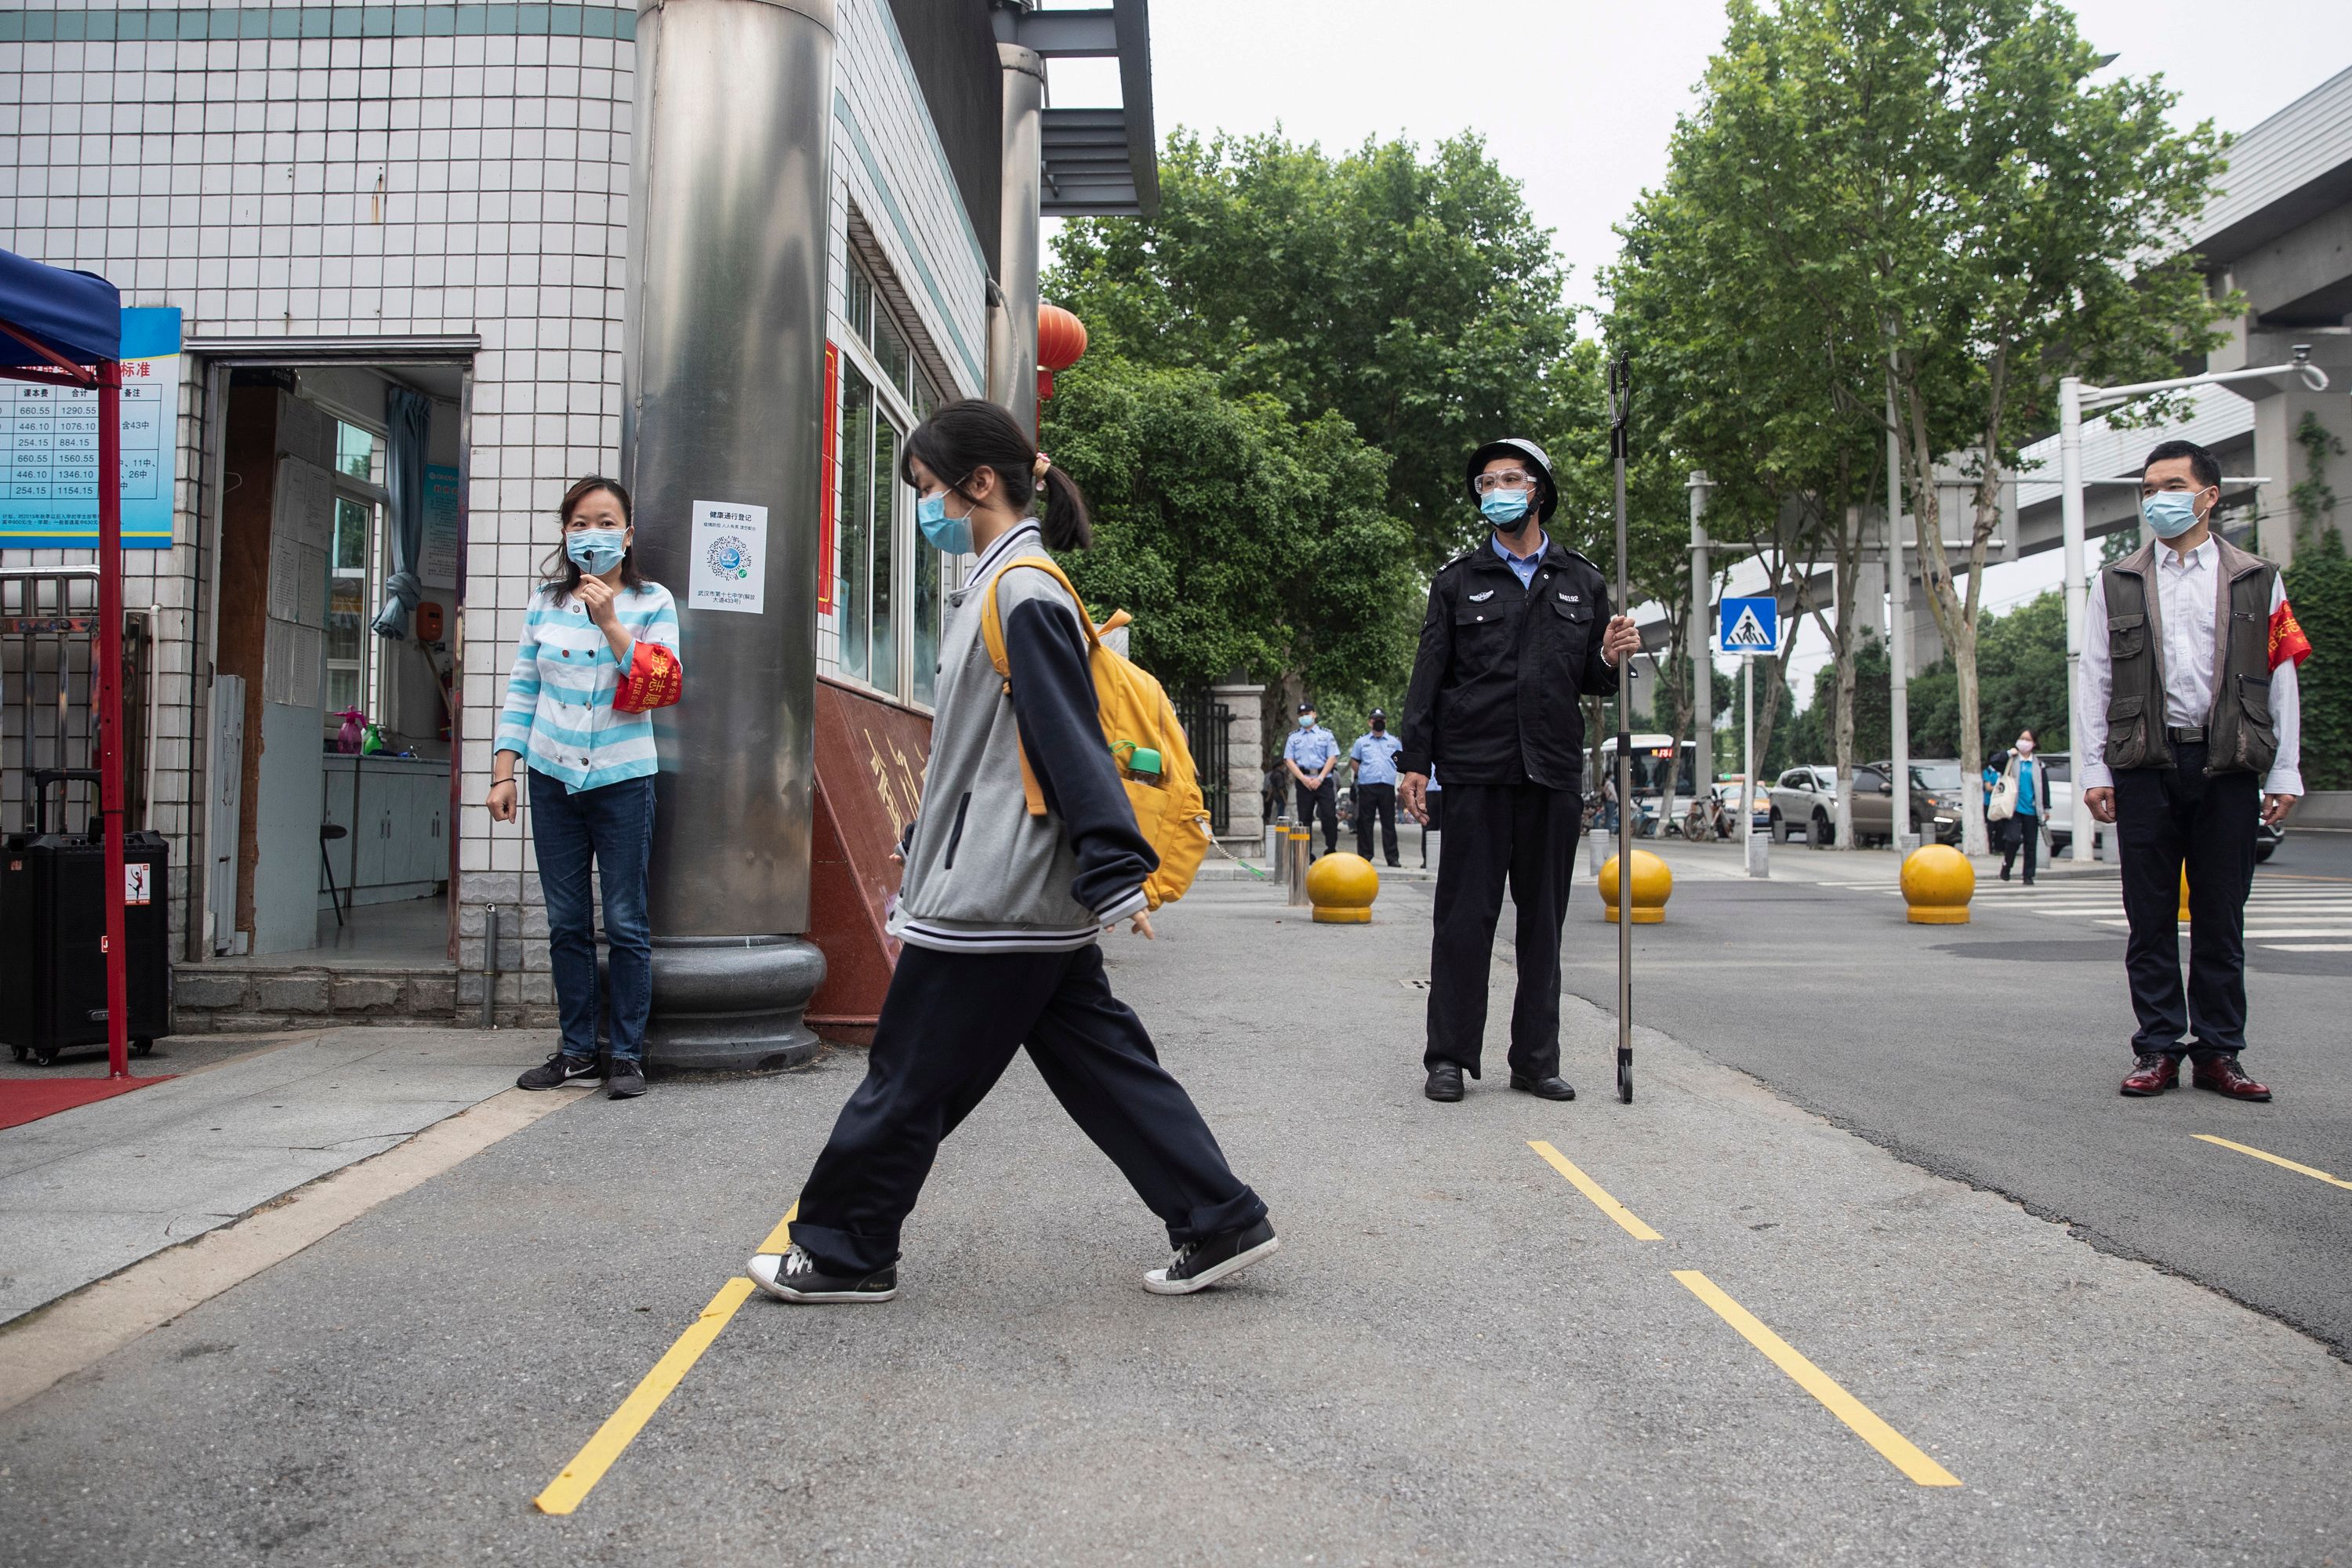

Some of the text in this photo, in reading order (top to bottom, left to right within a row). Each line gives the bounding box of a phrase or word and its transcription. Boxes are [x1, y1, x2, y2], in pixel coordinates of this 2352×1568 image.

[122, 362, 151, 377] 标准
[24, 388, 141, 397] 课本费 合计 备注
[62, 406, 96, 415] 1290.55
[18, 438, 90, 447] 254.15 884.15
[16, 470, 93, 479] 446.10 1346.10
[16, 486, 46, 495] 254.15
[710, 511, 753, 522] 健康通行登记
